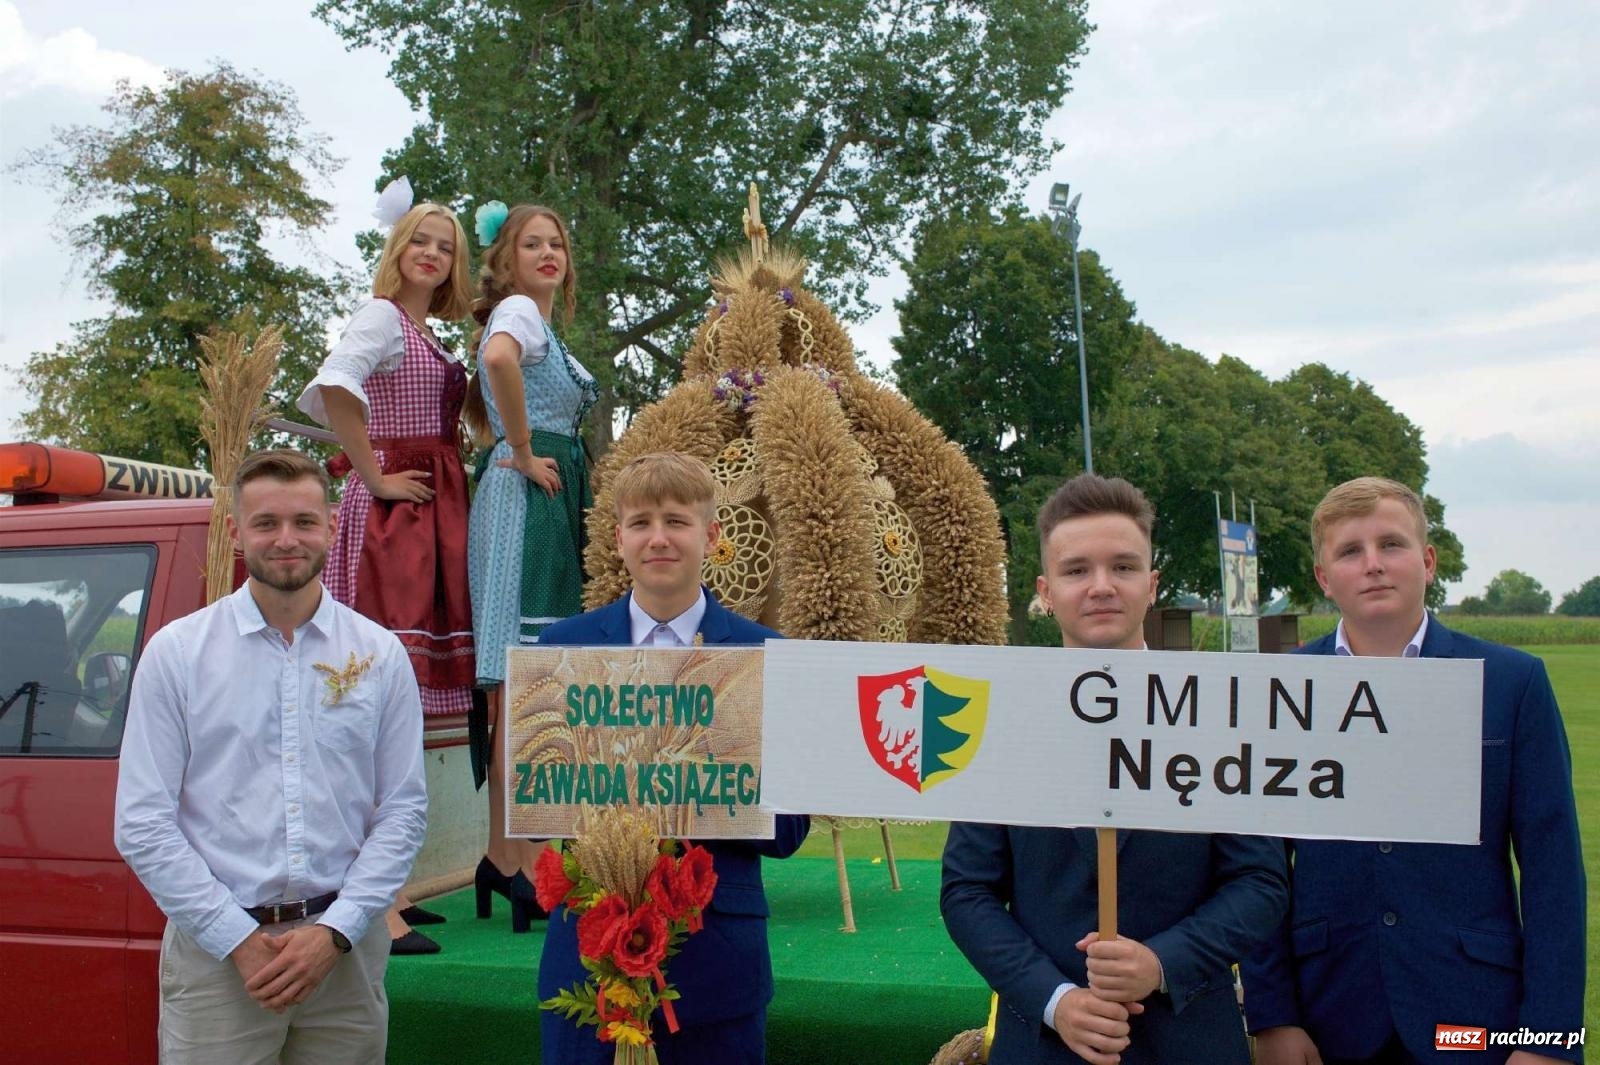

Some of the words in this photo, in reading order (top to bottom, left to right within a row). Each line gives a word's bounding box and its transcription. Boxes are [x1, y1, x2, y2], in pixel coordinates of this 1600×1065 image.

[107, 461, 214, 498] ZWiUK
[566, 684, 714, 726] SOŁECTWO
[1070, 671, 1388, 734] GMINA
[515, 764, 629, 805] ZAWADA
[1109, 738, 1345, 806] Nędza
